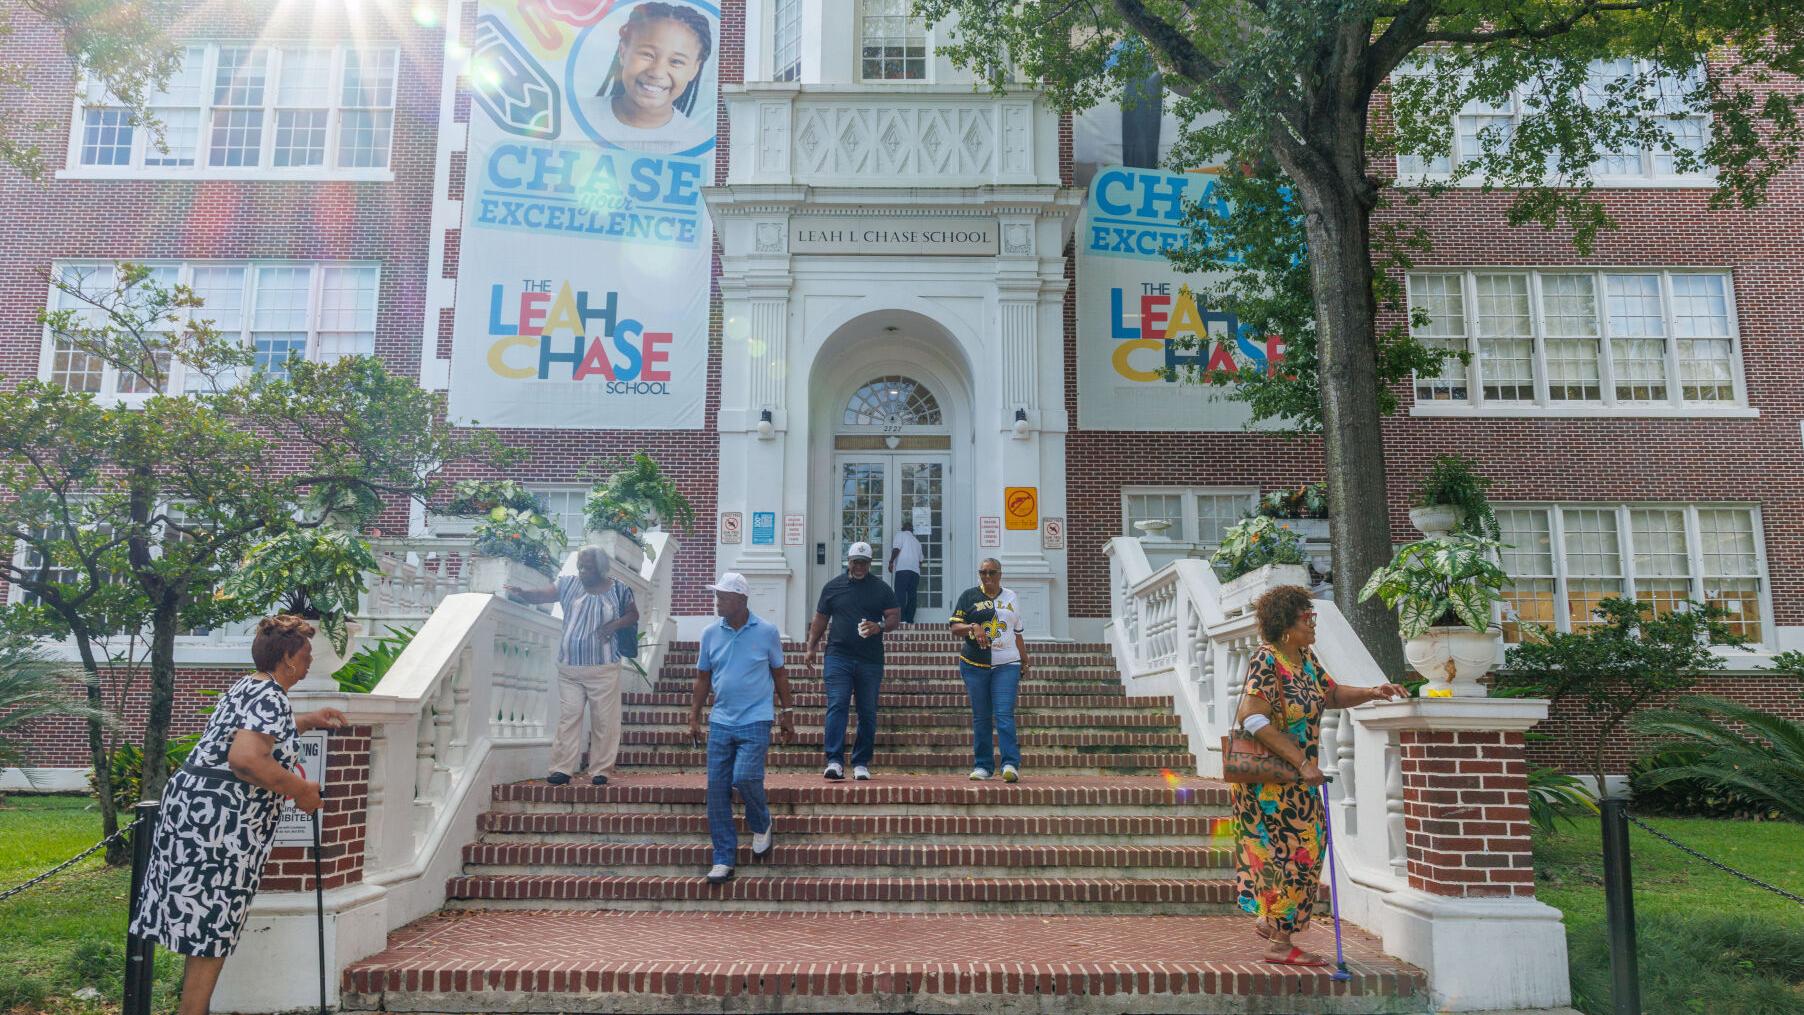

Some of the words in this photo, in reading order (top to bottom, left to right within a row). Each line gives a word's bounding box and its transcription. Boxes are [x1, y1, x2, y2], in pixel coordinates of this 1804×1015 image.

[487, 144, 701, 206] CHASE
[1095, 171, 1292, 224] CHA
[477, 199, 697, 243] EXCELLENCE
[799, 230, 843, 242] LEAH
[863, 230, 918, 243] CHASE
[922, 231, 991, 243] SCHOOL
[523, 279, 552, 292] THE
[1140, 282, 1171, 296] THE
[488, 279, 618, 338] LEAH
[1111, 282, 1238, 340] LEAH
[487, 318, 673, 382] CHASE
[606, 381, 670, 395] SCHOOL
[280, 813, 313, 823] IBITED
